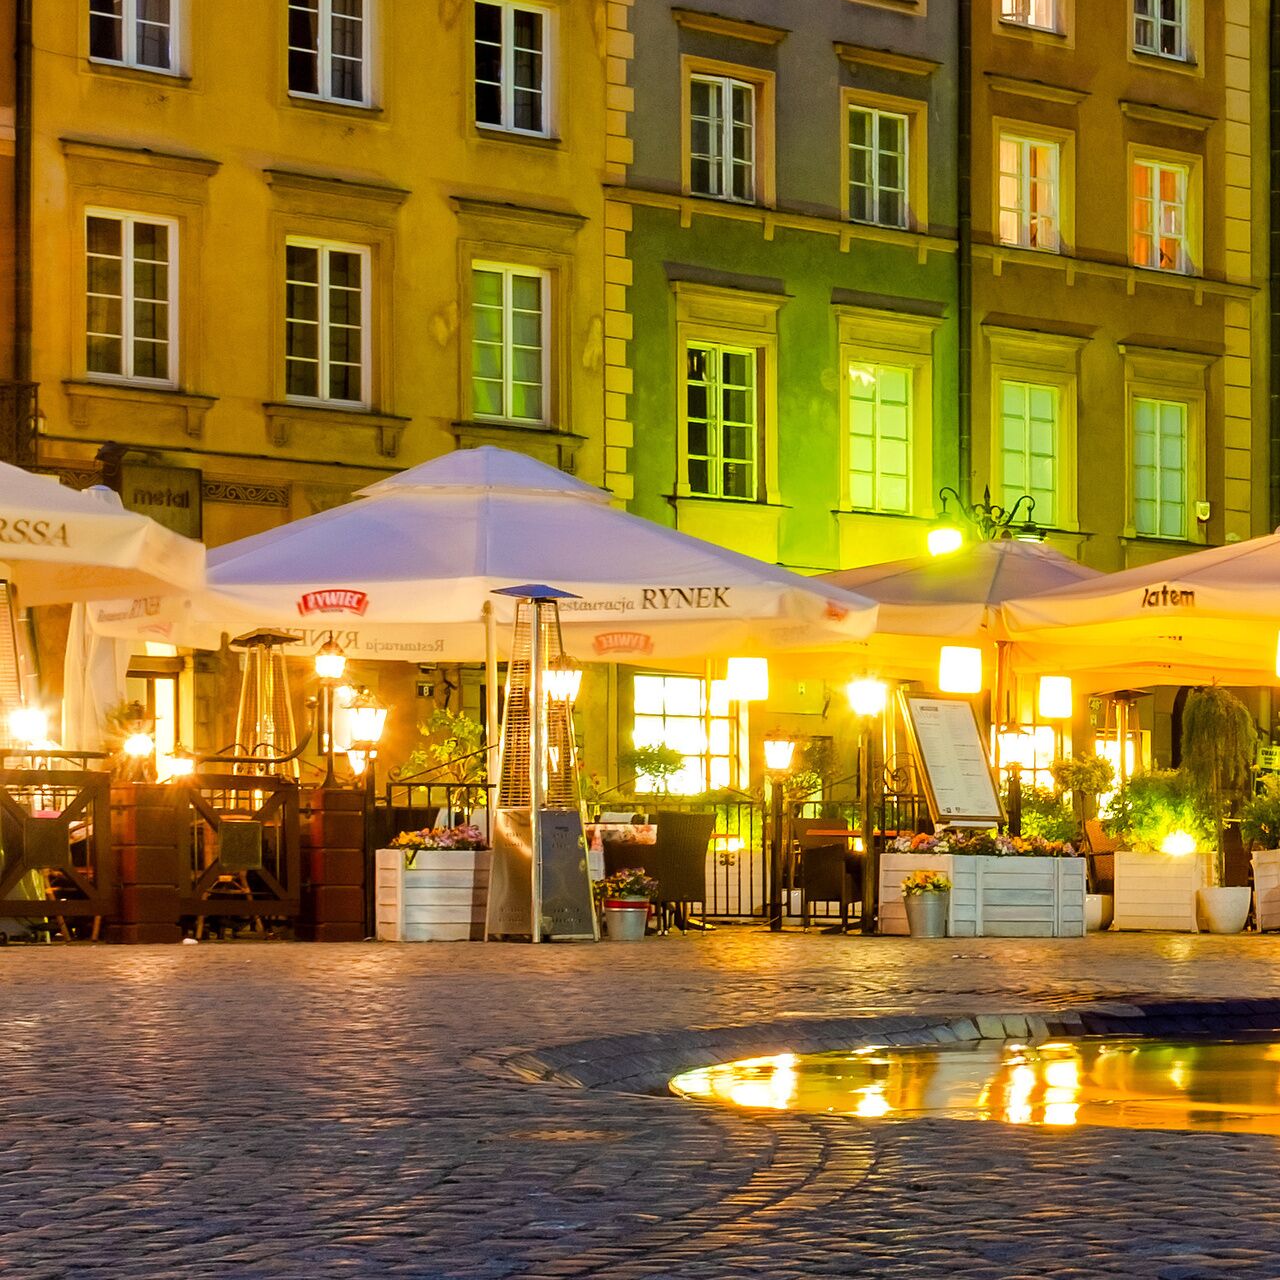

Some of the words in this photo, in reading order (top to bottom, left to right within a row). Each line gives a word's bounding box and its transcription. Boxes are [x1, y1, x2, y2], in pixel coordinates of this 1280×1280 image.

[133, 488, 190, 508] metal
[544, 597, 634, 614] estauracja
[641, 587, 731, 610] RYNEK
